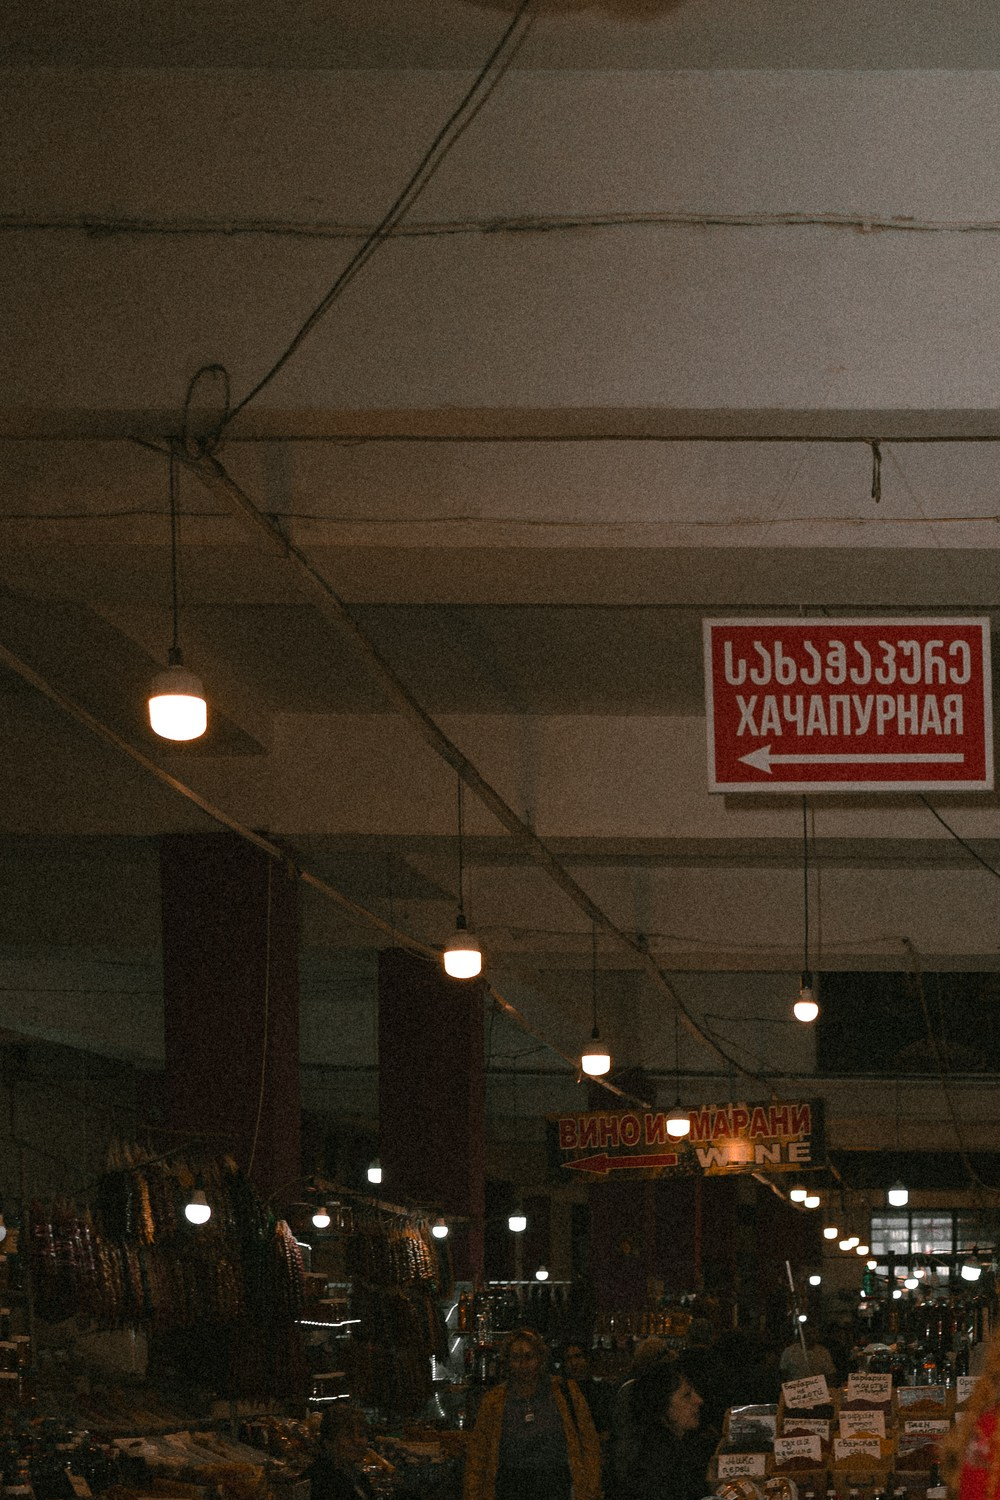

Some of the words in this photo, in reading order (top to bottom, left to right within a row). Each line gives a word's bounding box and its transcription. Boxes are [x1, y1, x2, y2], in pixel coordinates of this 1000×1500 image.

[723, 639, 972, 686] სახაჭაპურე
[735, 693, 965, 737] ХАЧАПУРНАЯ
[558, 1114, 641, 1150] ВИНО
[688, 1103, 812, 1143] МАРАНИ
[696, 1141, 812, 1168] WNE
